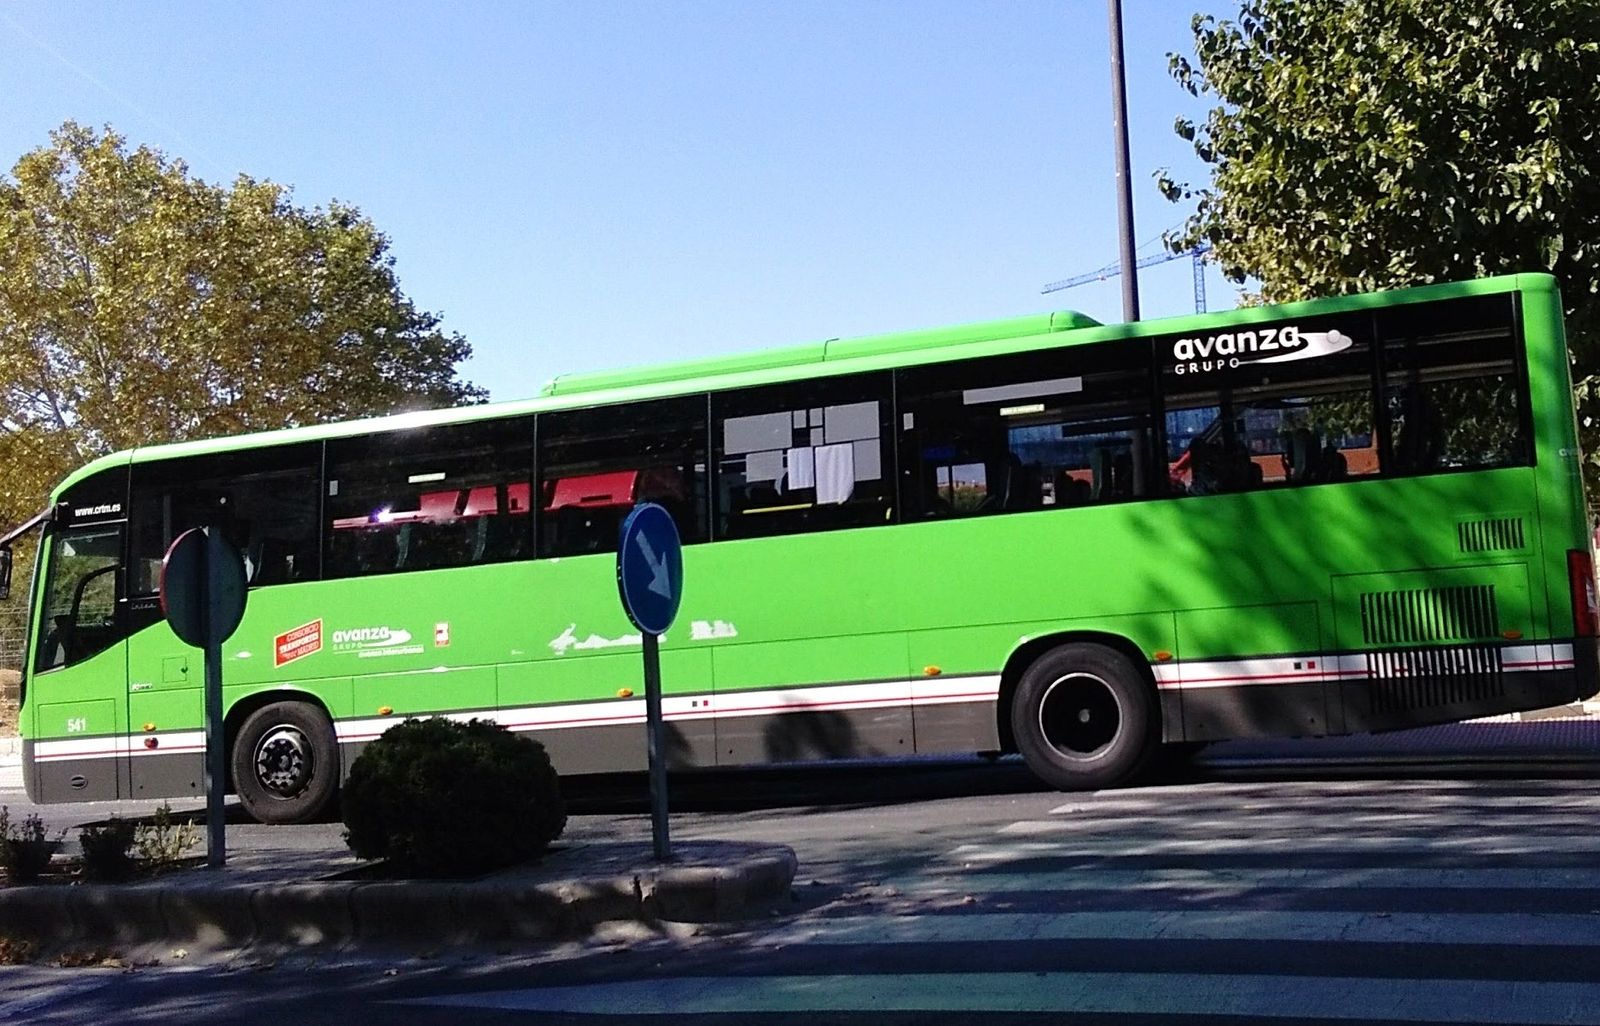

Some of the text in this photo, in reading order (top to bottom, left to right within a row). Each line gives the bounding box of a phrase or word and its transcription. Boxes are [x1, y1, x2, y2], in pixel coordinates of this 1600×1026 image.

[1173, 326, 1301, 360] avanza
[1174, 358, 1239, 375] GRUPO
[74, 503, 121, 517] www.crtm.es
[332, 626, 390, 643] avanza
[67, 717, 87, 732] 541
